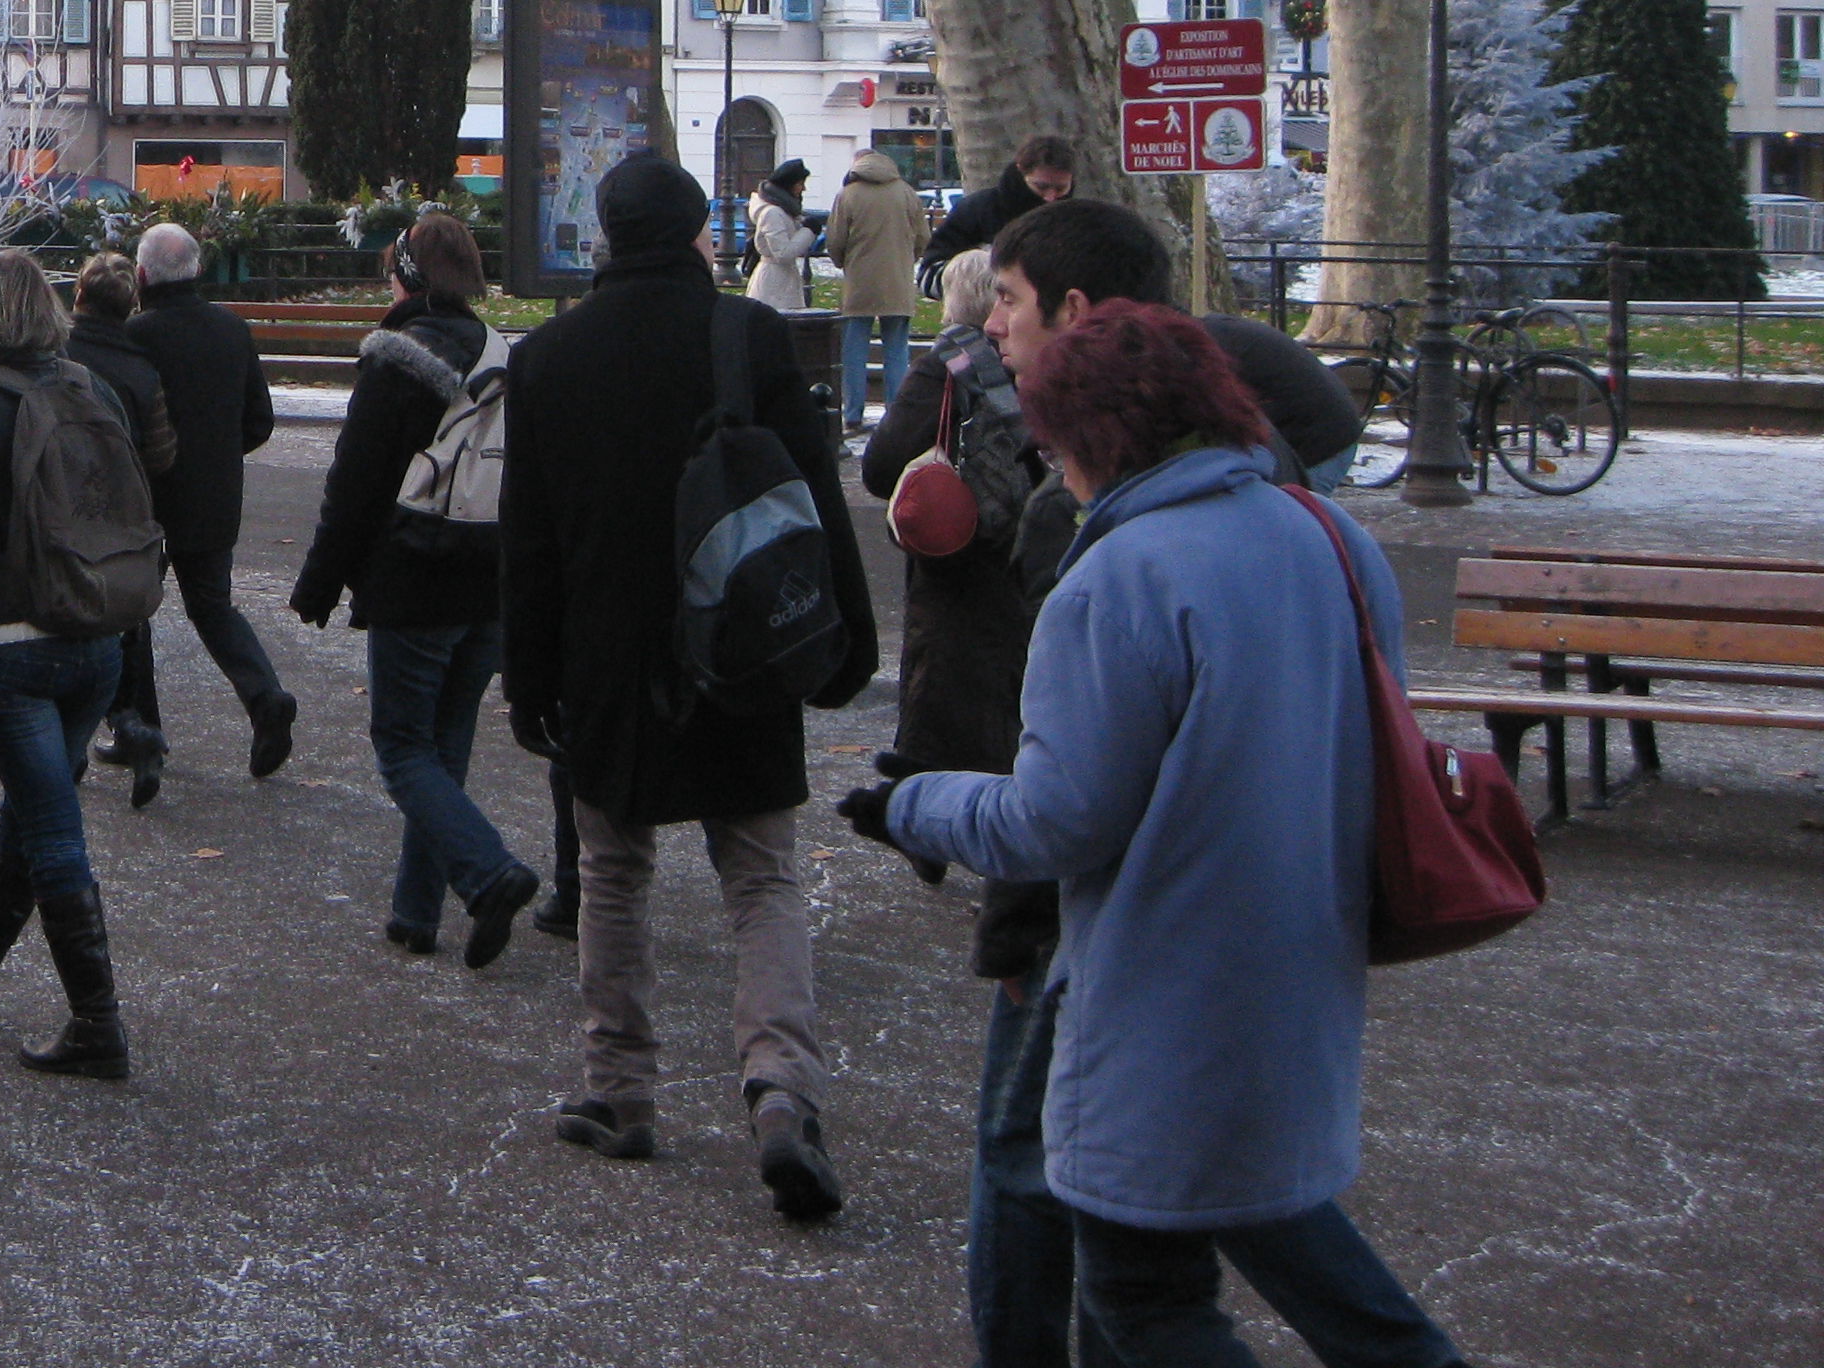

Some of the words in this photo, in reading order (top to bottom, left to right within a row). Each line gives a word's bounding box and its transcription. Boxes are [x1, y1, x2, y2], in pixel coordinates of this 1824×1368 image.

[1180, 30, 1229, 43] EXPOSITION
[1190, 65, 1206, 76] DES
[1207, 63, 1263, 76] DOMINICAINS
[1133, 156, 1150, 168] DE
[768, 587, 821, 628] adidas
